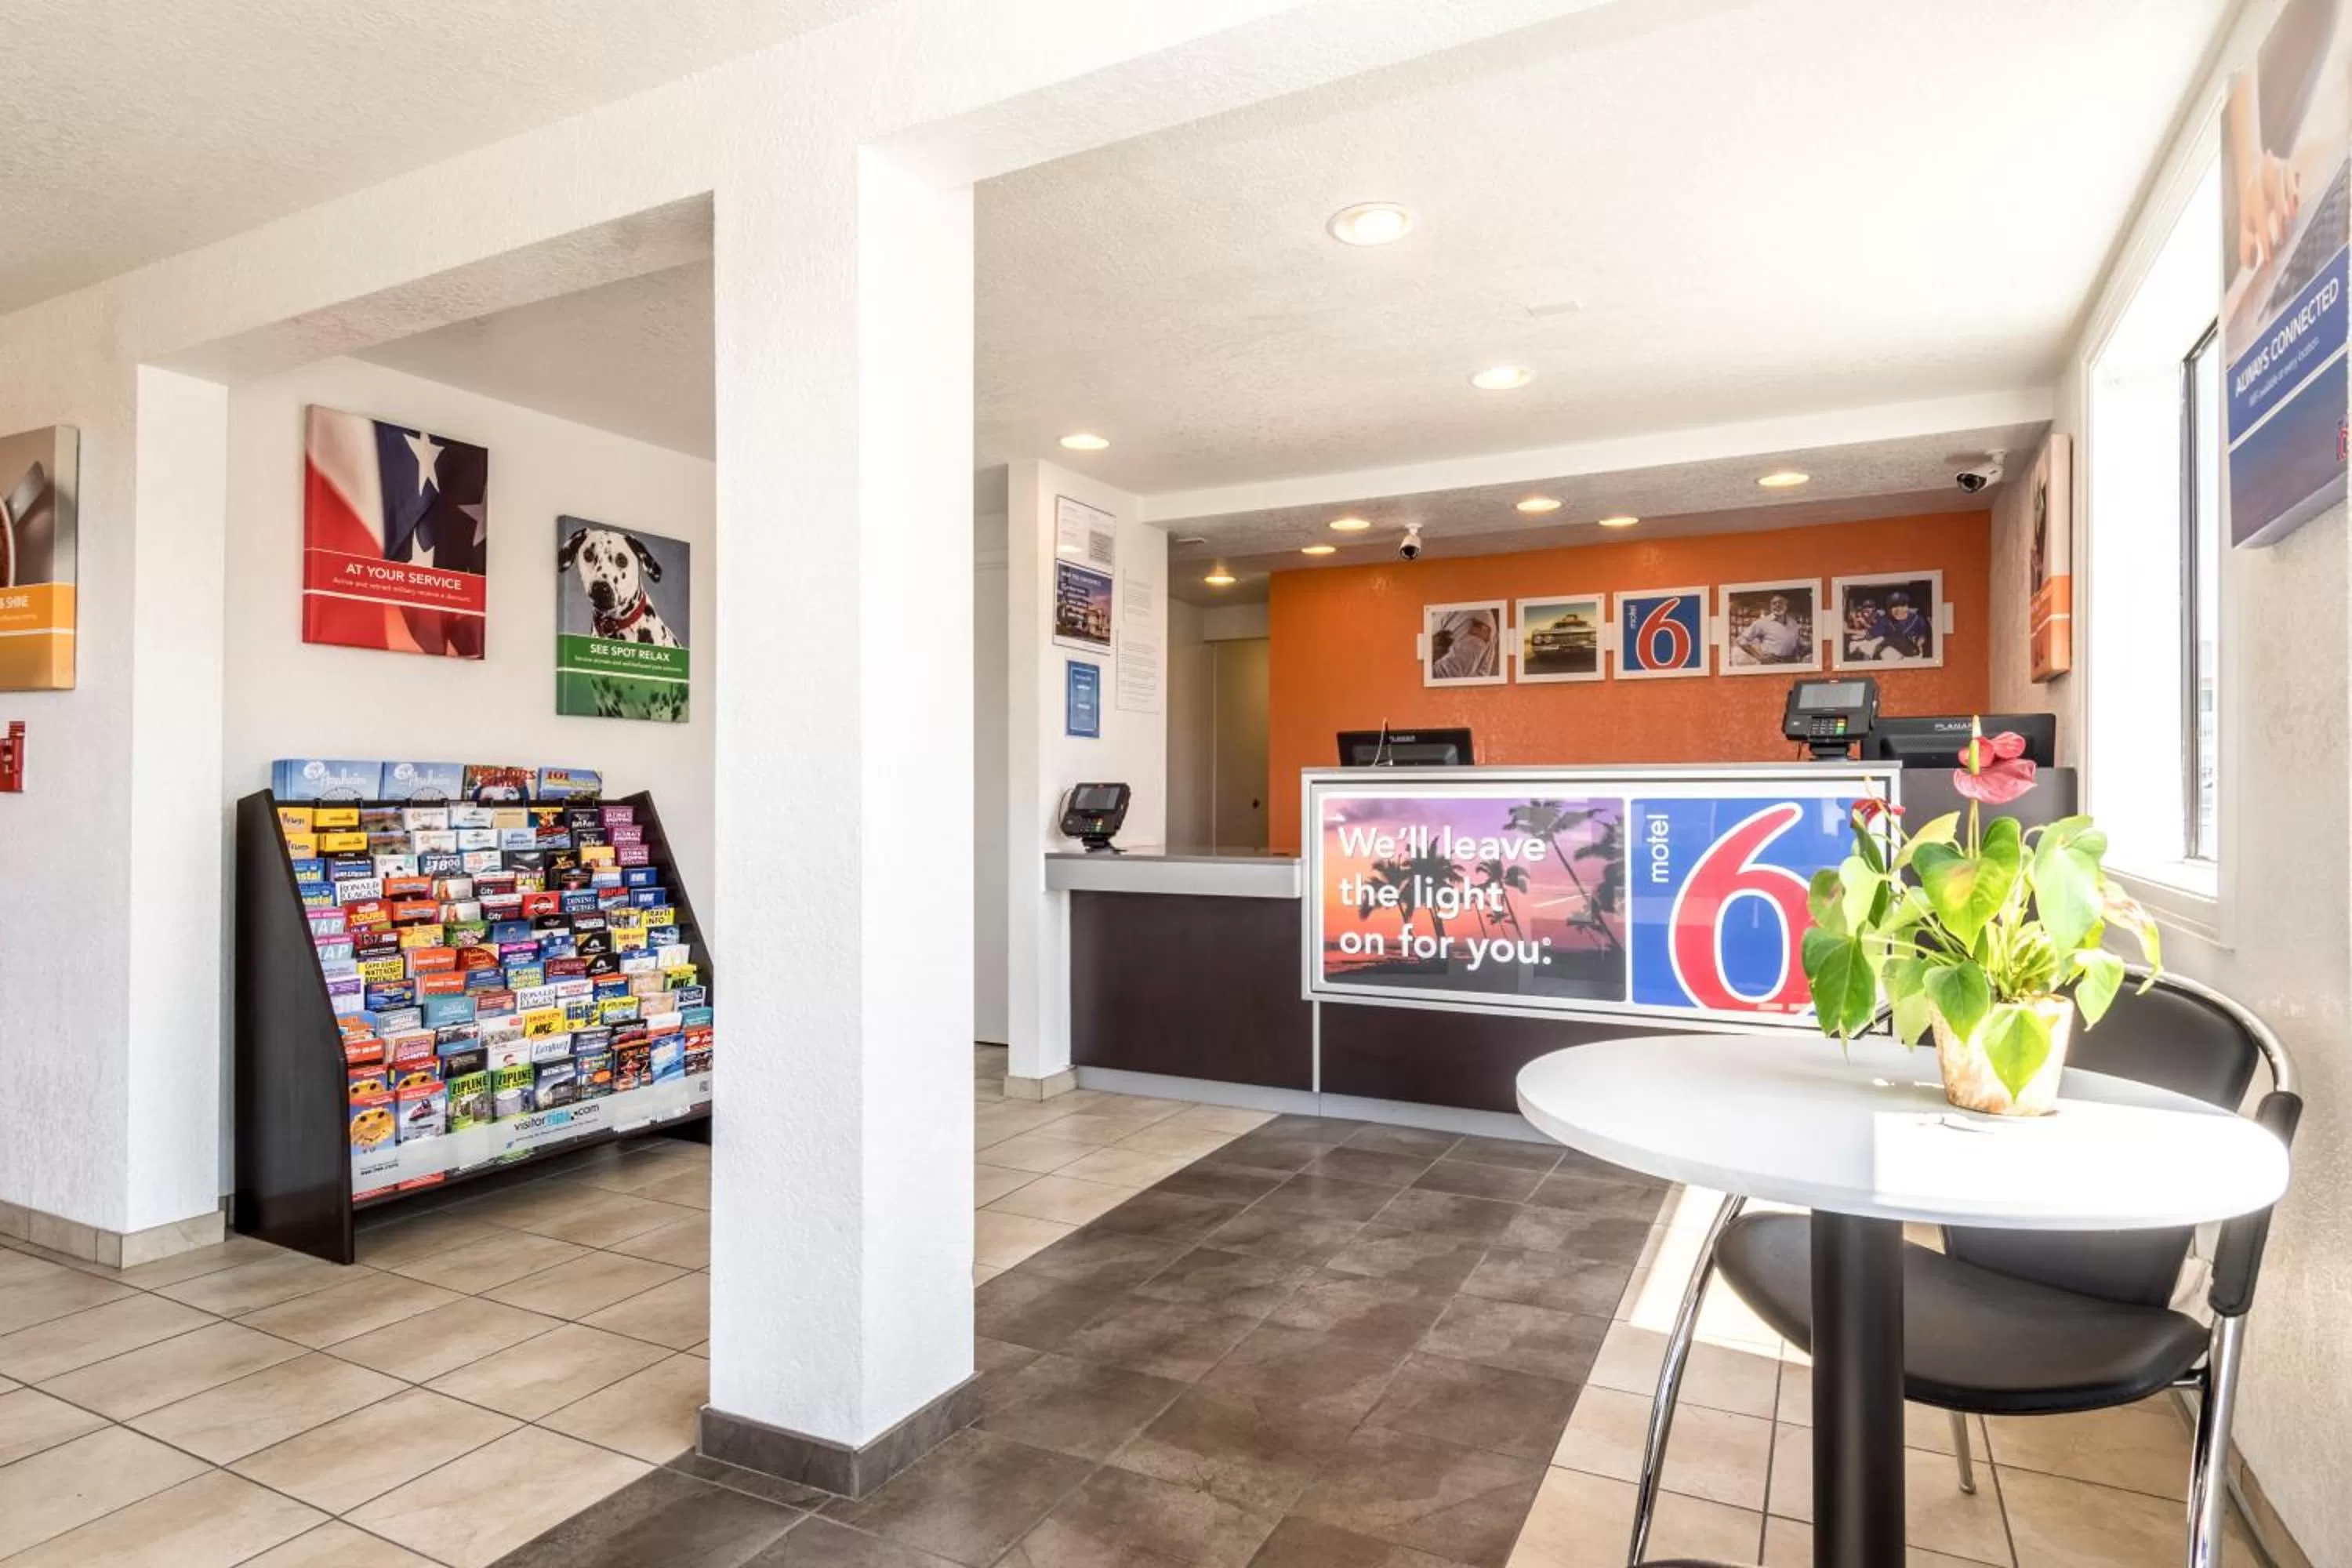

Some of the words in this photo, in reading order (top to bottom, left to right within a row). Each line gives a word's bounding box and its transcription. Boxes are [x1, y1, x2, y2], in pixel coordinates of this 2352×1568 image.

[2234, 344, 2270, 397] ALWAYS
[2270, 278, 2339, 361] CONNECTED
[346, 563, 364, 575] AT
[367, 566, 405, 582] YOUR
[408, 572, 462, 590] SERVICE
[1635, 597, 1691, 670] 6
[590, 643, 609, 656] SEE
[611, 646, 637, 659] SPOT
[638, 650, 671, 662] RELAX
[1338, 826, 1428, 859] We'll
[1443, 826, 1547, 862] leave
[1646, 815, 1669, 884] motel
[1339, 873, 1399, 908] the
[1414, 875, 1504, 920] light
[1668, 802, 1814, 1015] 6
[1339, 931, 1385, 955] on
[1399, 924, 1455, 960] for
[452, 1074, 489, 1095] ZIPLINE
[497, 1068, 532, 1087] ZIPLINE
